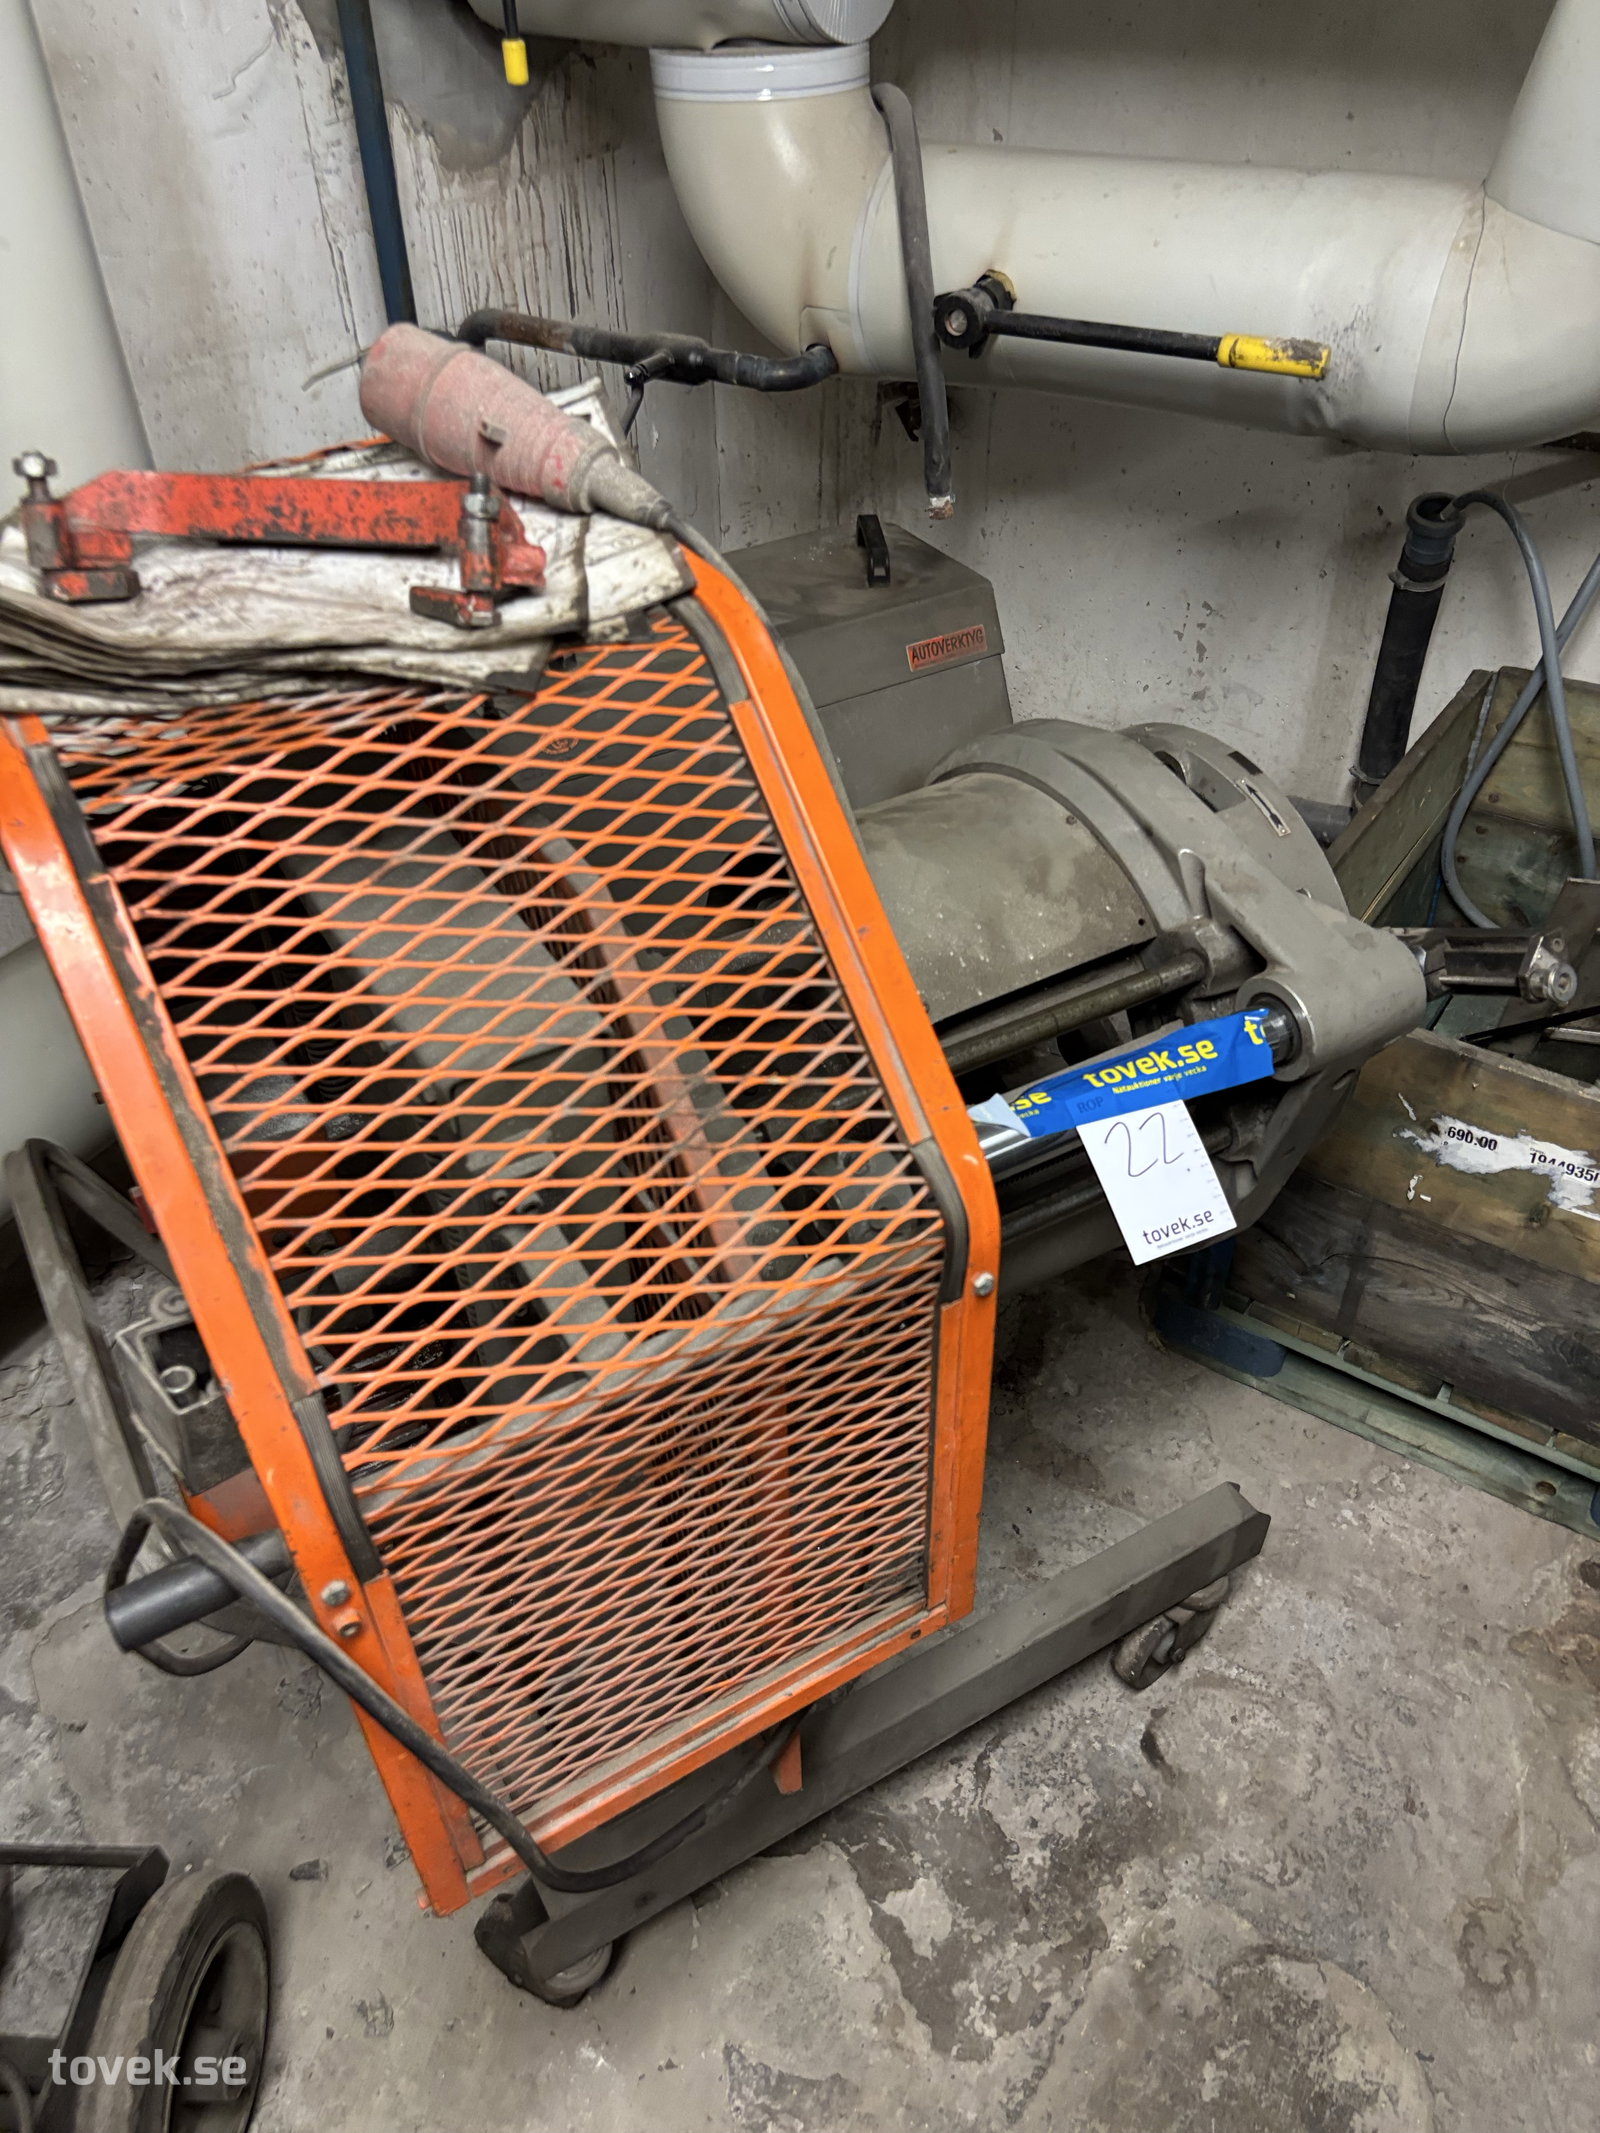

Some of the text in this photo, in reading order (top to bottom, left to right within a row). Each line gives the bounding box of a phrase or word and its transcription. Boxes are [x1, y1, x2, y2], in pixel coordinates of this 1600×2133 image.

[912, 629, 984, 661] AUTOVERKTYG
[1083, 1038, 1219, 1088] tovek.se
[1104, 1112, 1184, 1177] 22
[1447, 1126, 1498, 1151] 690.00
[1142, 1209, 1214, 1245] tovek.se
